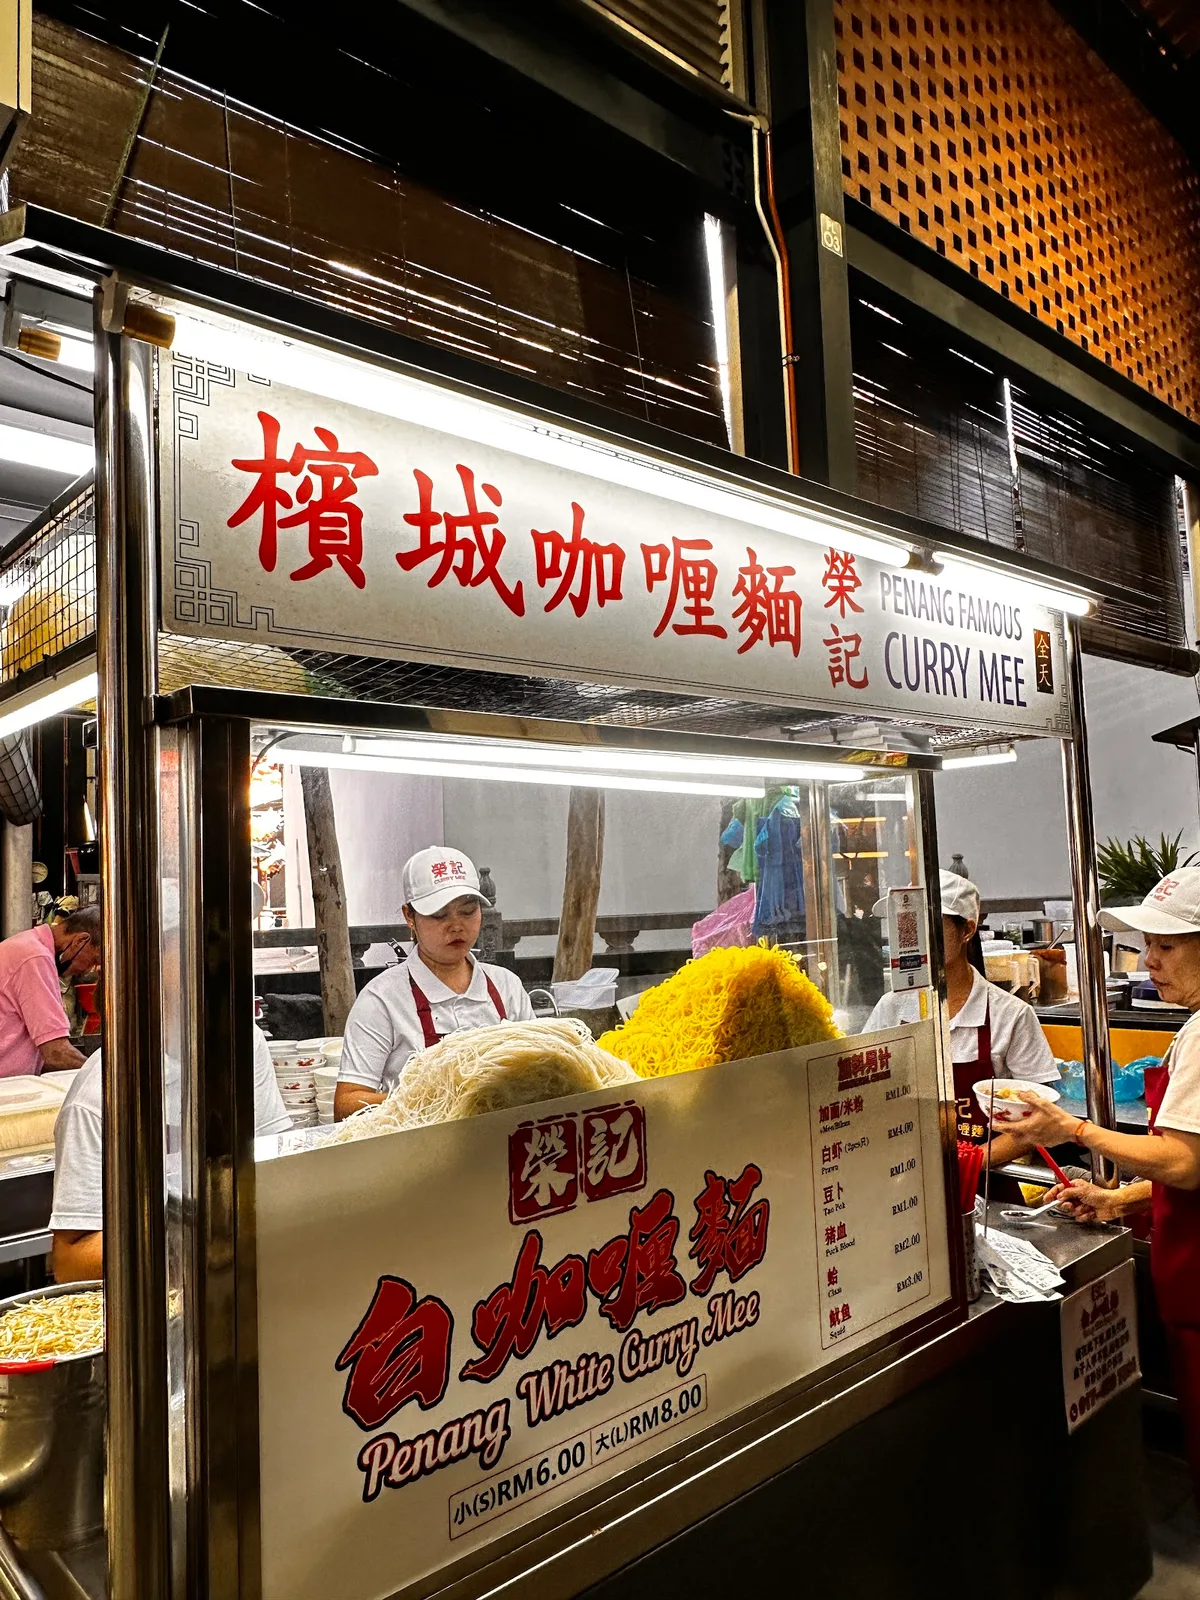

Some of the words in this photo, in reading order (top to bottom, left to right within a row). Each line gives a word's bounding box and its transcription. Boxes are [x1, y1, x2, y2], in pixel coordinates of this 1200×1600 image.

[824, 231, 840, 252] 03
[227, 411, 803, 658] 檳城咖喱麵
[822, 547, 870, 689] 榮記
[880, 571, 956, 627] PENANG
[958, 592, 1023, 641] FAMOUS
[884, 631, 970, 699] CURRY
[979, 653, 1027, 707] MEE
[1036, 634, 1052, 687] 全天
[885, 1084, 911, 1101] RM1.00
[888, 1120, 914, 1139] RM4.00
[516, 1108, 643, 1211] 榮記
[890, 1158, 916, 1177] RM1.00
[823, 1181, 844, 1205] 豆卜
[892, 1195, 918, 1216] RM1.00
[894, 1232, 921, 1254] RM2.00
[335, 1163, 770, 1430] 白咖喱麵
[896, 1270, 923, 1293] RM3.00
[357, 1398, 511, 1502] Penang
[516, 1352, 614, 1428] White
[618, 1315, 700, 1376] Curry
[702, 1289, 760, 1347] Mee
